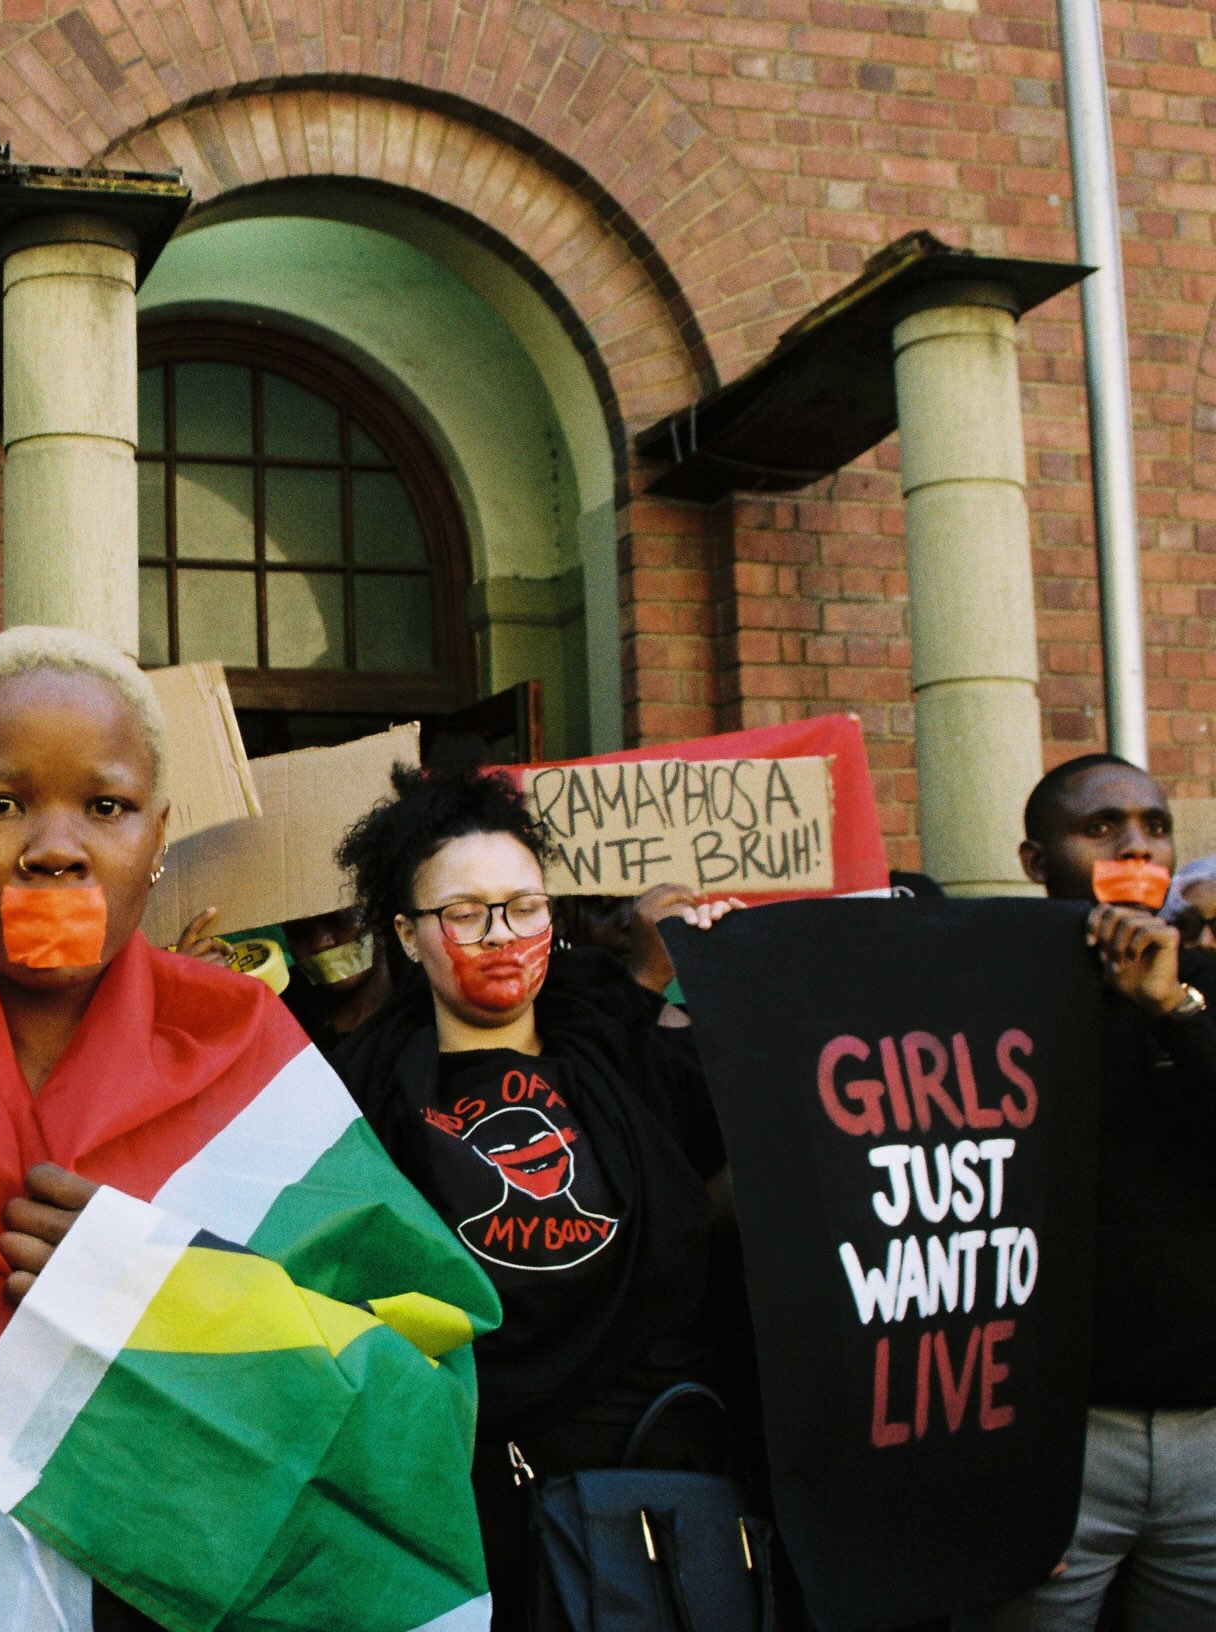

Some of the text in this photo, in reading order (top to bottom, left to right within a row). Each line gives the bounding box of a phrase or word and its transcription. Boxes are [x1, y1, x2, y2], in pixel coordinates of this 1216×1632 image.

[533, 760, 802, 838] RAMAPHOSA
[558, 818, 823, 888] WTF BRUH!
[817, 1028, 1039, 1136] GIRLS
[869, 1138, 1016, 1227] JUST
[483, 1215, 611, 1253] MY BODY
[839, 1227, 1039, 1325] WANT TO
[871, 1319, 1016, 1448] LIVE
